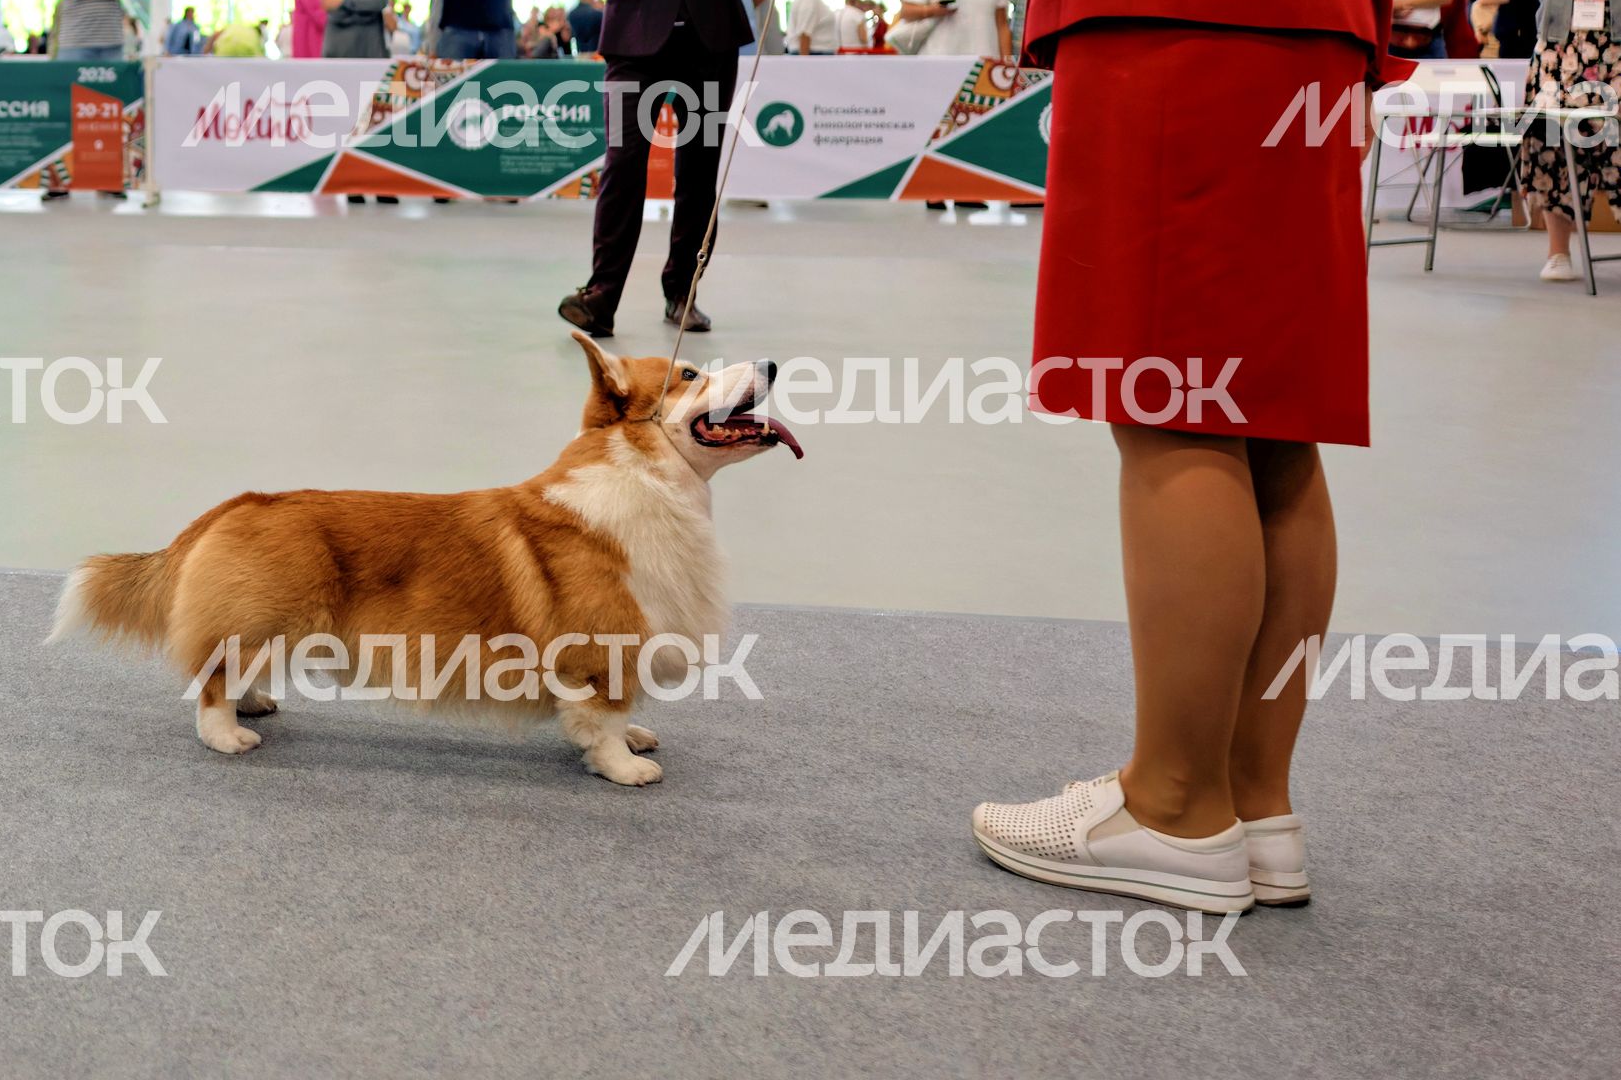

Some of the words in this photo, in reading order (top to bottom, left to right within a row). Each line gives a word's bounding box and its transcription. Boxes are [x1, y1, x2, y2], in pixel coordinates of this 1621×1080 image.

[77, 66, 118, 83] 2026
[75, 102, 119, 118] 20-21
[501, 104, 591, 122] РОССИЯ
